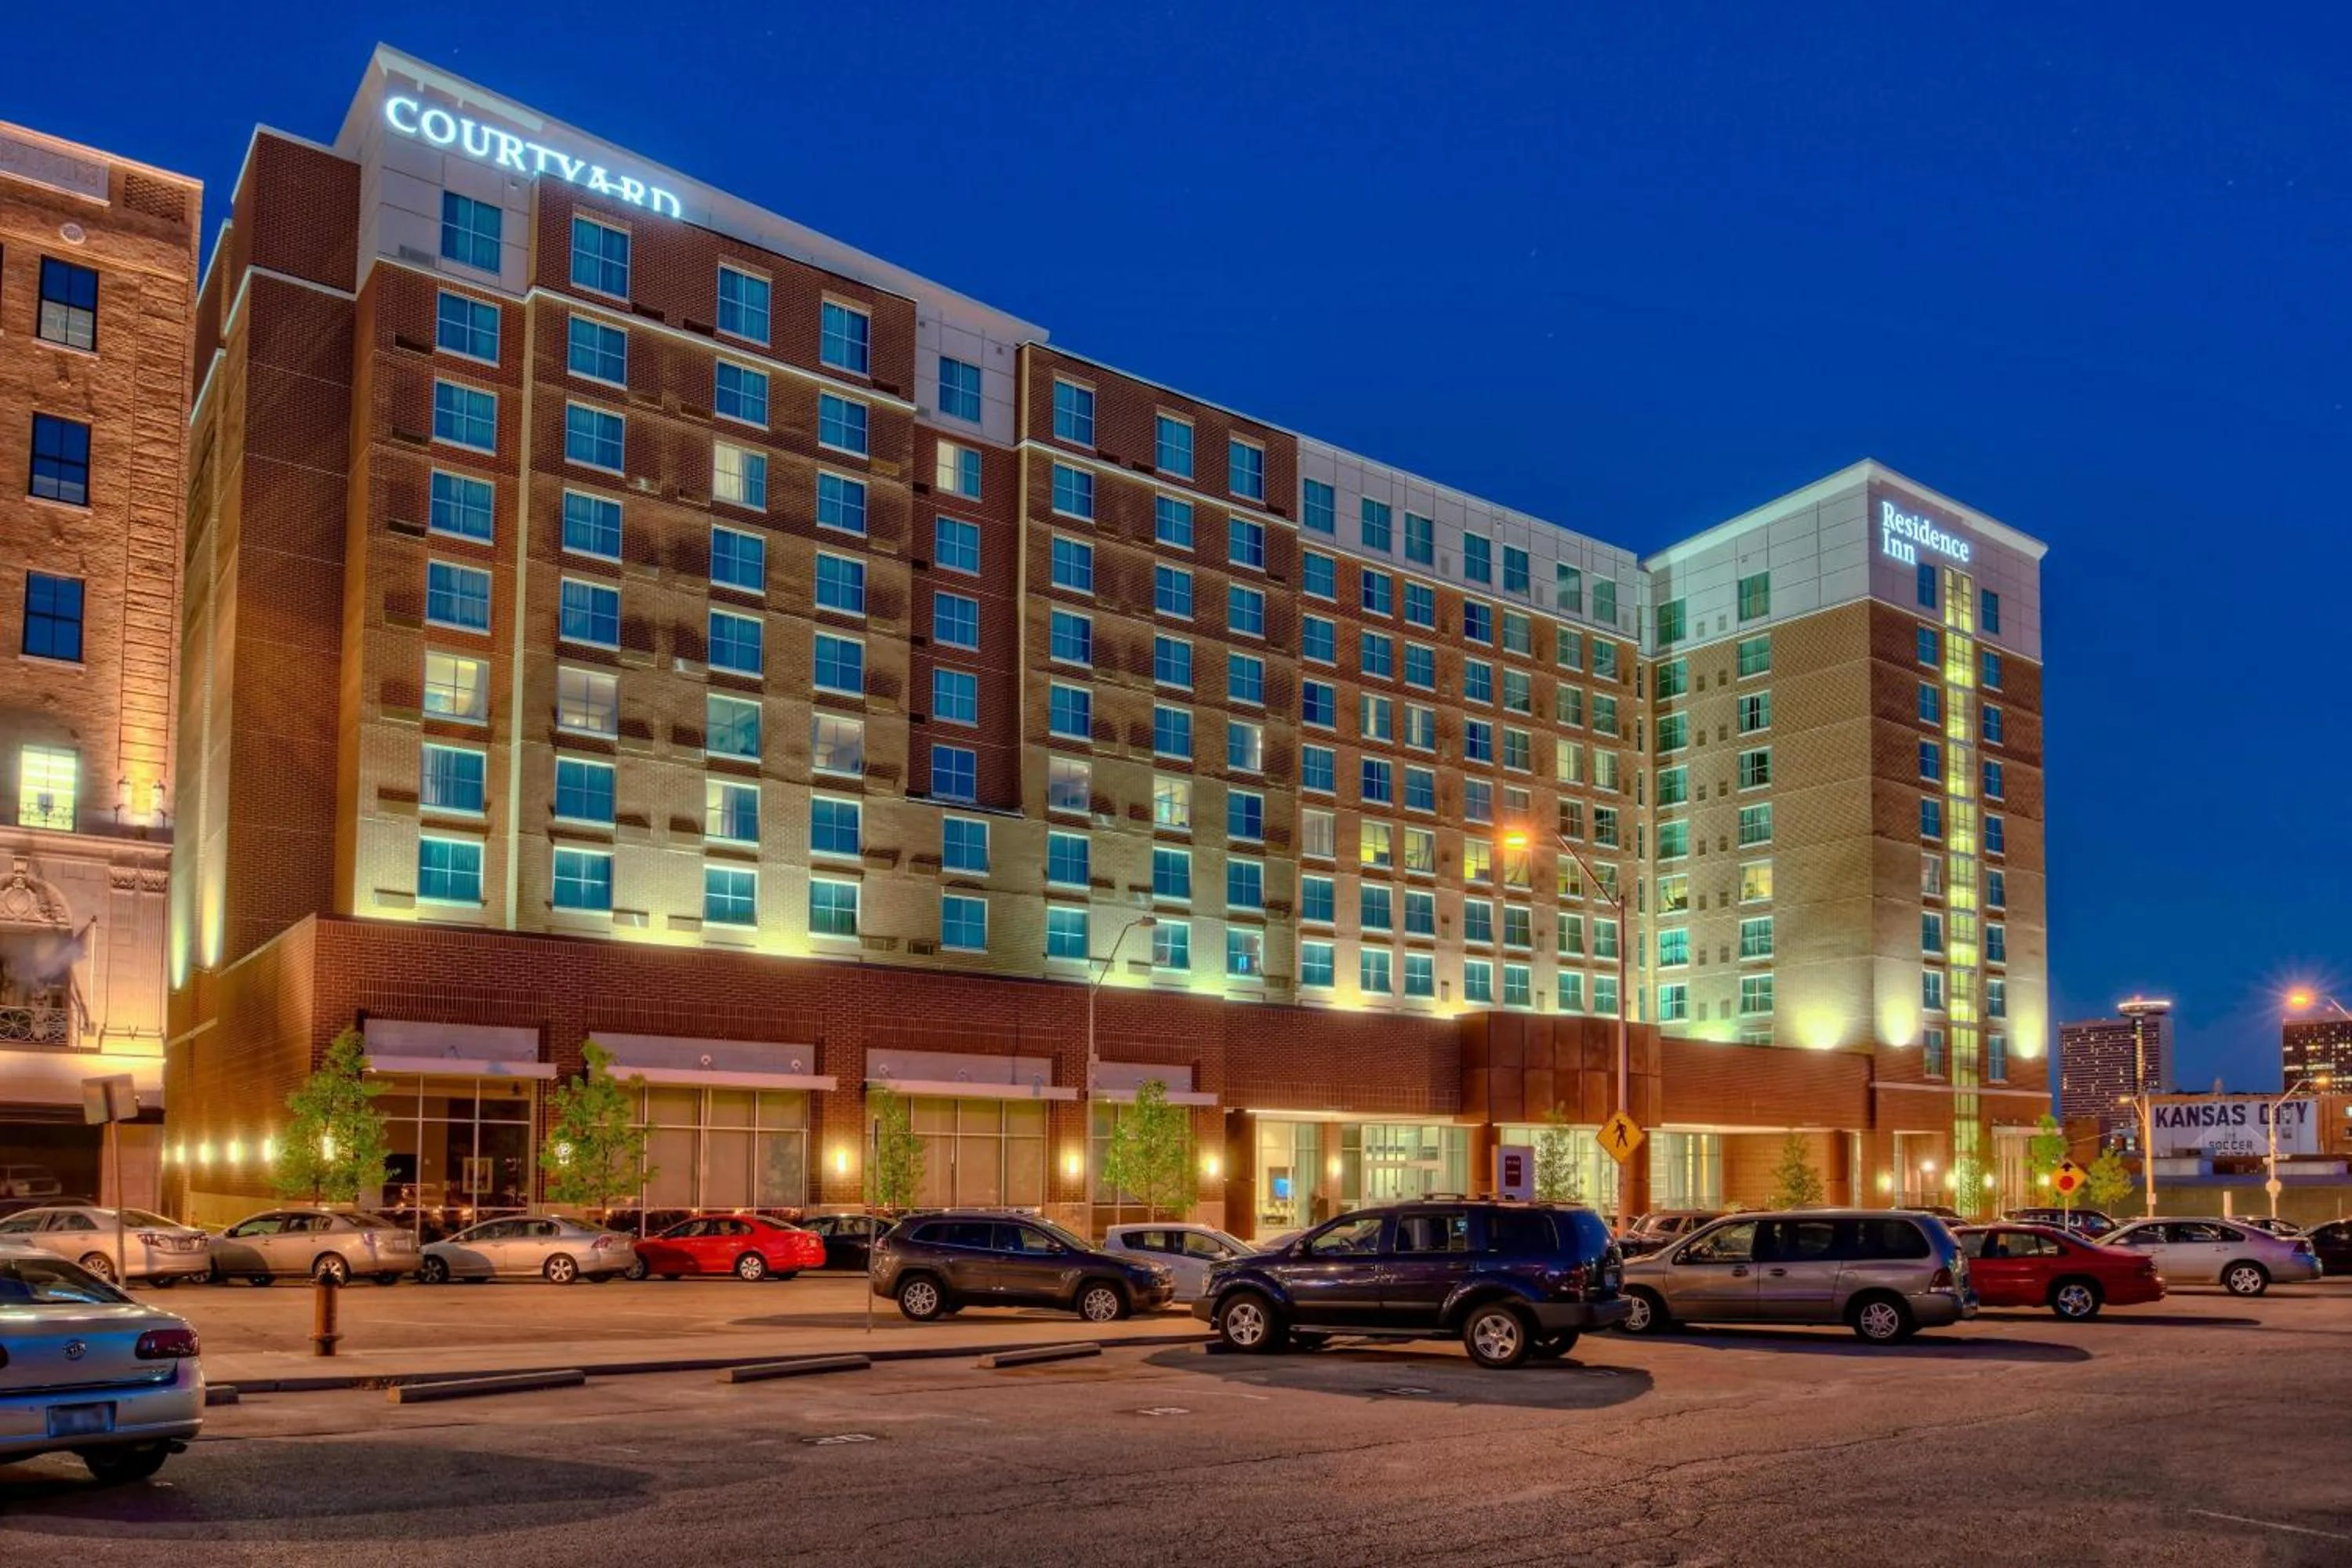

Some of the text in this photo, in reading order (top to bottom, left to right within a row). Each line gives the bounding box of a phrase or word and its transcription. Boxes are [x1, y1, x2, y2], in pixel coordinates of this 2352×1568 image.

[385, 96, 681, 218] COURTYARD
[1882, 501, 1969, 563] Residence
[1882, 528, 1916, 564] Inn
[2155, 1105, 2246, 1127] KANSAS
[2208, 1141, 2253, 1150] SOCCER
